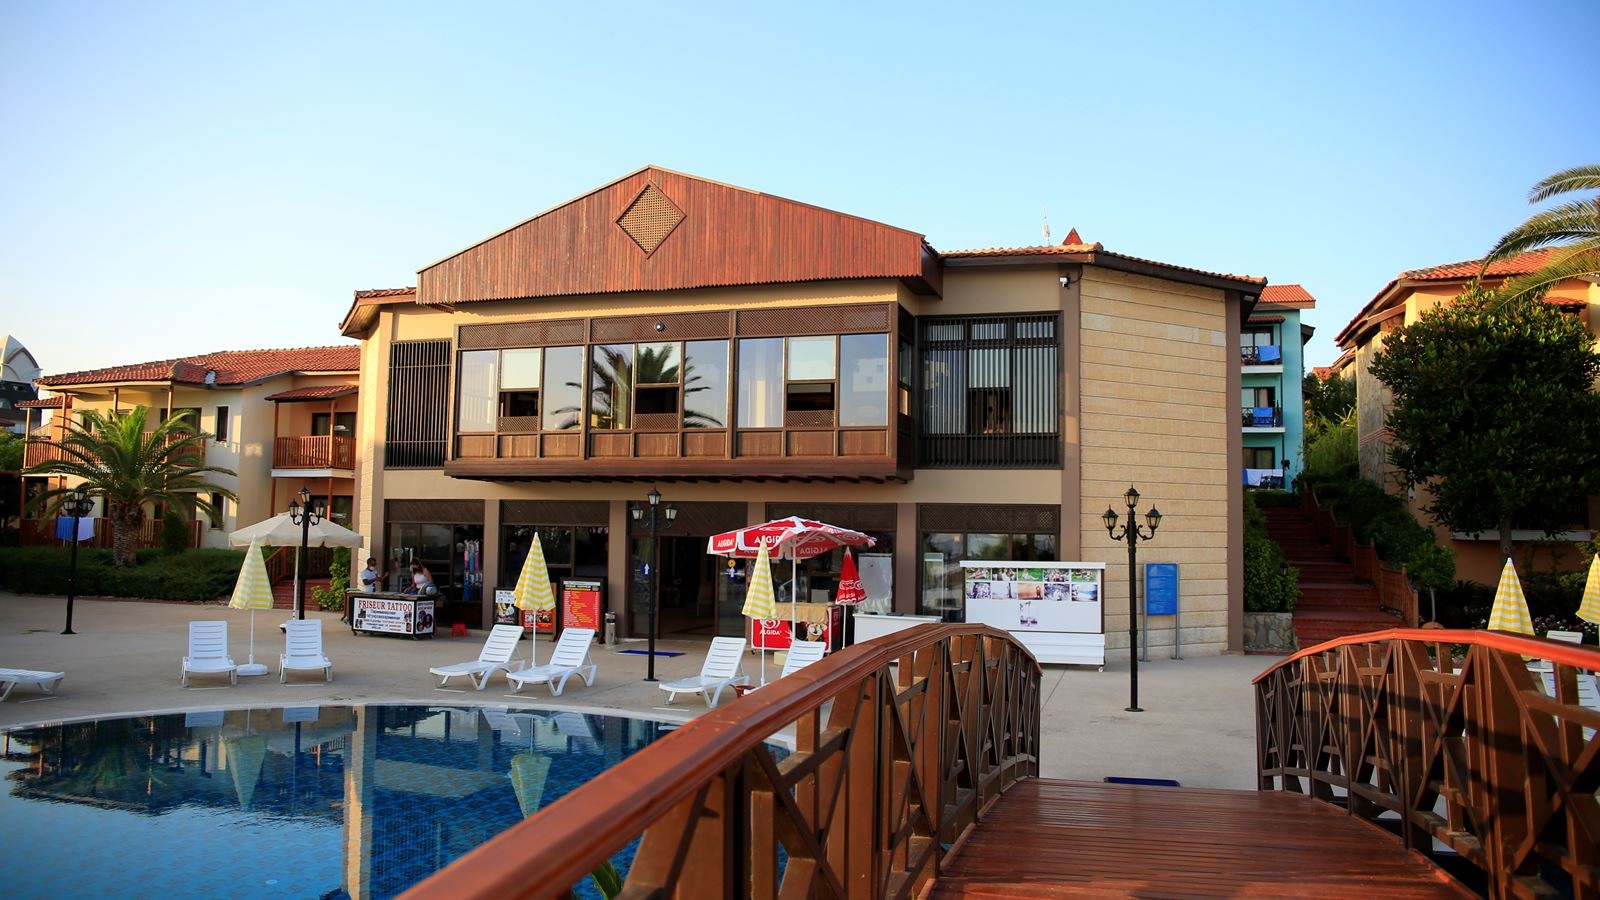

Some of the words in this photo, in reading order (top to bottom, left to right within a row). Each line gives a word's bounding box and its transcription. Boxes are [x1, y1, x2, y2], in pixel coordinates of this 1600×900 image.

[717, 539, 733, 548] ALGIDA
[358, 600, 385, 610] FRISEUR
[387, 602, 412, 611] TATTOO
